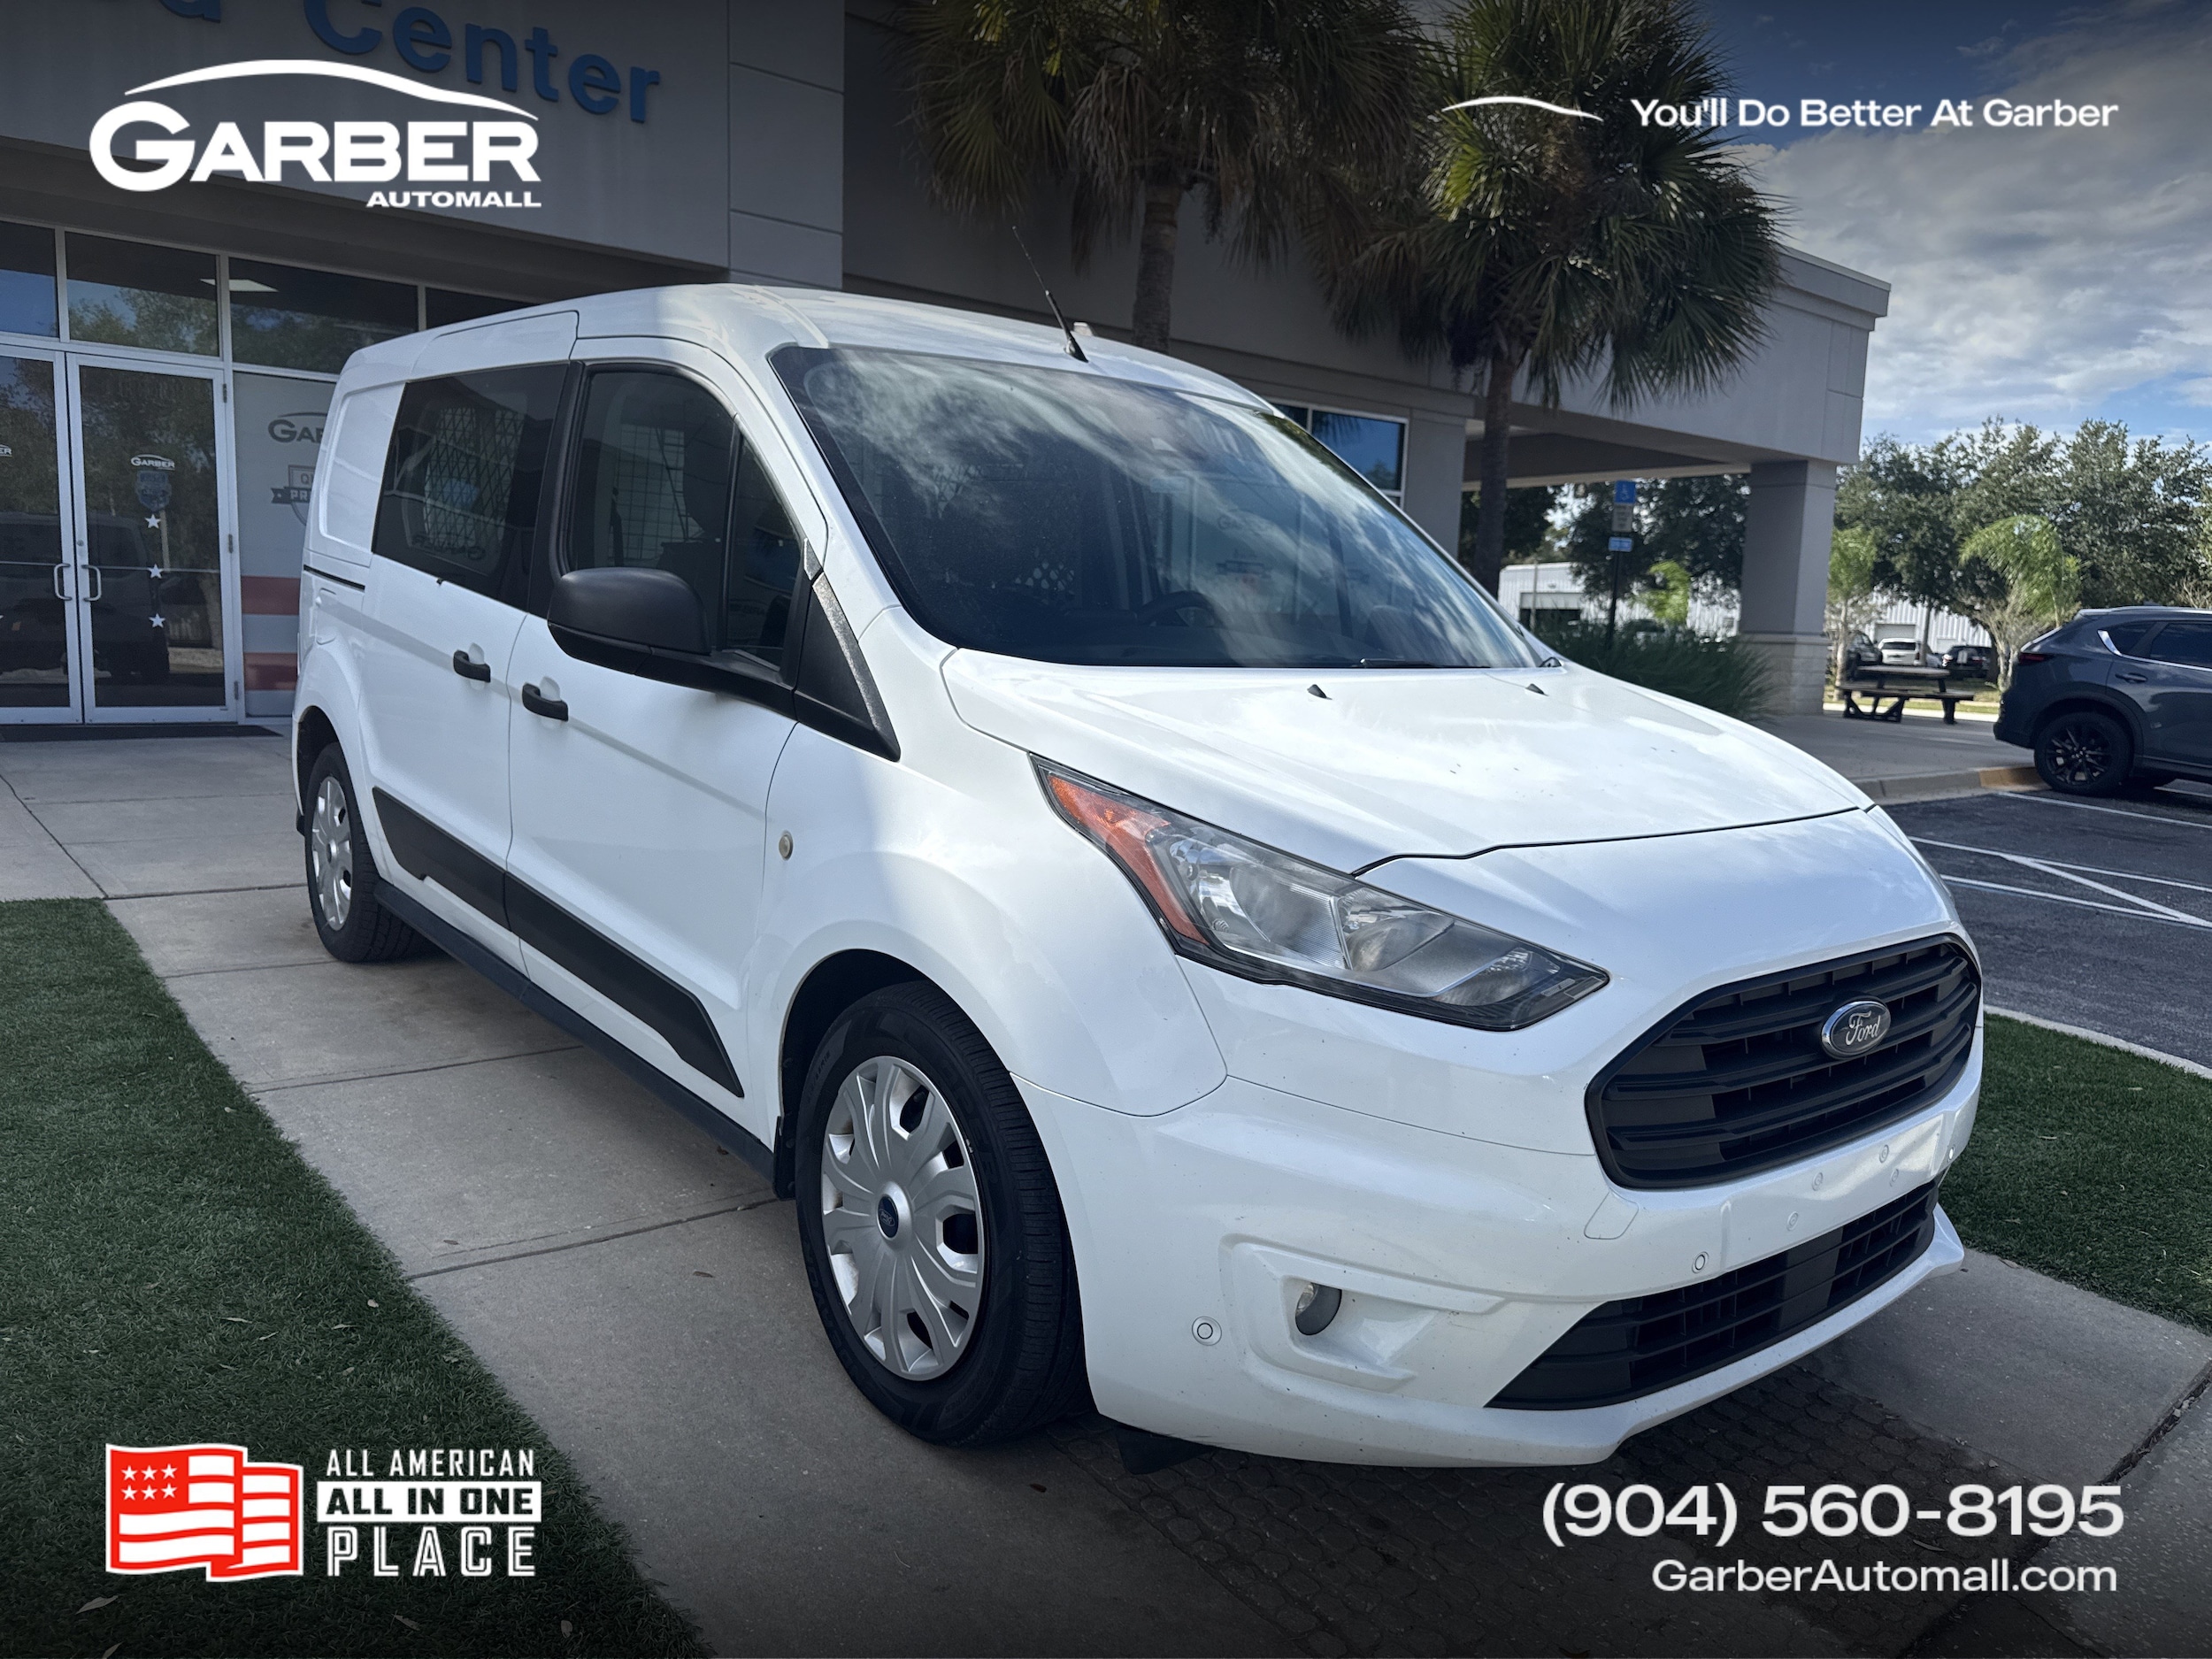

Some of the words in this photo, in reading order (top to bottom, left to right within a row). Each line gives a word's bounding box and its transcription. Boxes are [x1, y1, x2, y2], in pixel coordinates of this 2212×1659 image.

[303, 0, 661, 124] Center
[131, 457, 175, 469] GARBER
[1845, 1010, 1881, 1046] Ford
